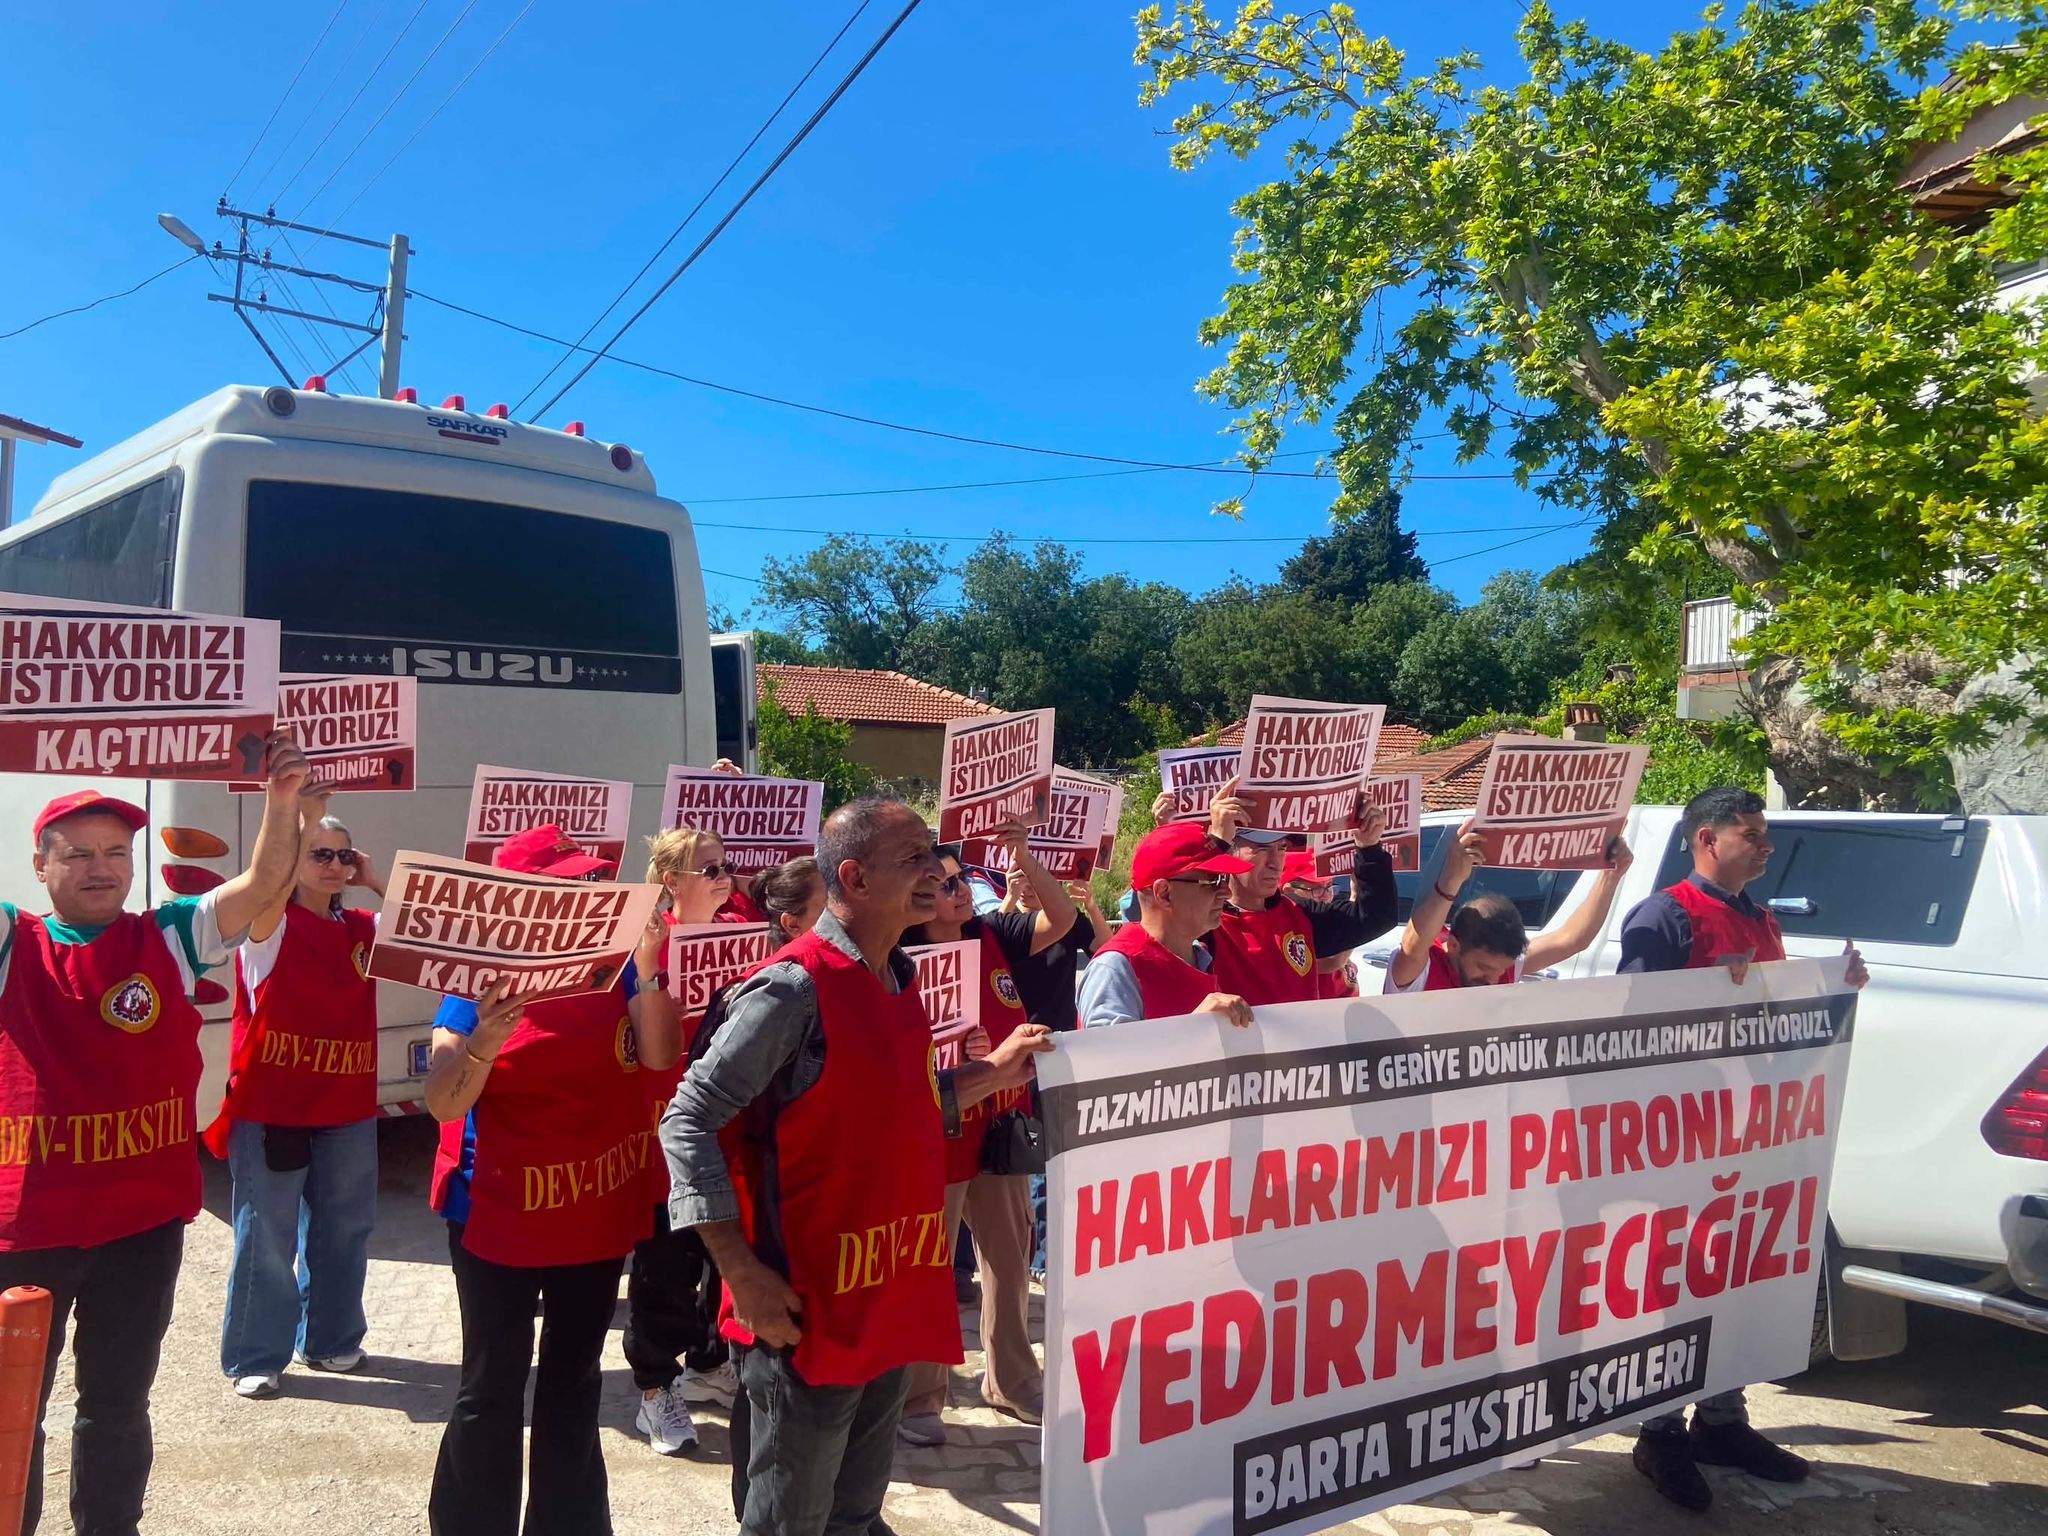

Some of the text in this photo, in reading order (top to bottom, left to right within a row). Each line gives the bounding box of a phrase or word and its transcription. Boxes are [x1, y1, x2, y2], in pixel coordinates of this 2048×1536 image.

[427, 416, 508, 438] SAFKAR
[2, 621, 245, 660] HAKKIMIZI
[0, 661, 244, 705] İSTİYORUZ!
[392, 647, 573, 683] ISUZU
[35, 724, 233, 774] KAÇTINIZ!
[951, 717, 1039, 766] HAKKIMIZI
[1255, 712, 1374, 746] HAKKIMIZI
[310, 757, 384, 784] RDÜNÜZ!
[949, 743, 1038, 797] İSTİYORUZ!
[1249, 741, 1368, 779] İSTİYORUZ!
[1493, 751, 1631, 783] HAKKIMIZI
[481, 783, 610, 807] HAKKIMIZI
[677, 784, 809, 809] HAKKIMIZI
[960, 785, 1034, 839] ÇALDINIZ!
[1267, 787, 1358, 831] KAÇTINIZ!
[1486, 780, 1623, 816] İSTİYORUZ!
[1499, 827, 1608, 867] KAÇTINIZ!
[403, 872, 631, 921] HAKKIMIZI
[394, 903, 619, 953] İSTİYORUZ!
[1077, 1063, 1331, 1136] TAZMİNATLARIMIZI
[1338, 1059, 1369, 1096] VE
[1378, 1043, 1461, 1090] GERİYE
[1469, 1034, 1548, 1078] DÖNÜK
[1555, 1020, 1723, 1068] ALACAKLARIMIZI
[1729, 1009, 1833, 1048] İSTİYORUZ!
[1074, 1074, 1825, 1277] HAKLARIMIZI PATRONLARA
[834, 1206, 950, 1295] DEV-TE
[1072, 1171, 1819, 1463] YEDİRMEYECEĞİZ!
[1244, 1334, 1698, 1520] BARTA TEKSTİL İŞÇİLERİ
